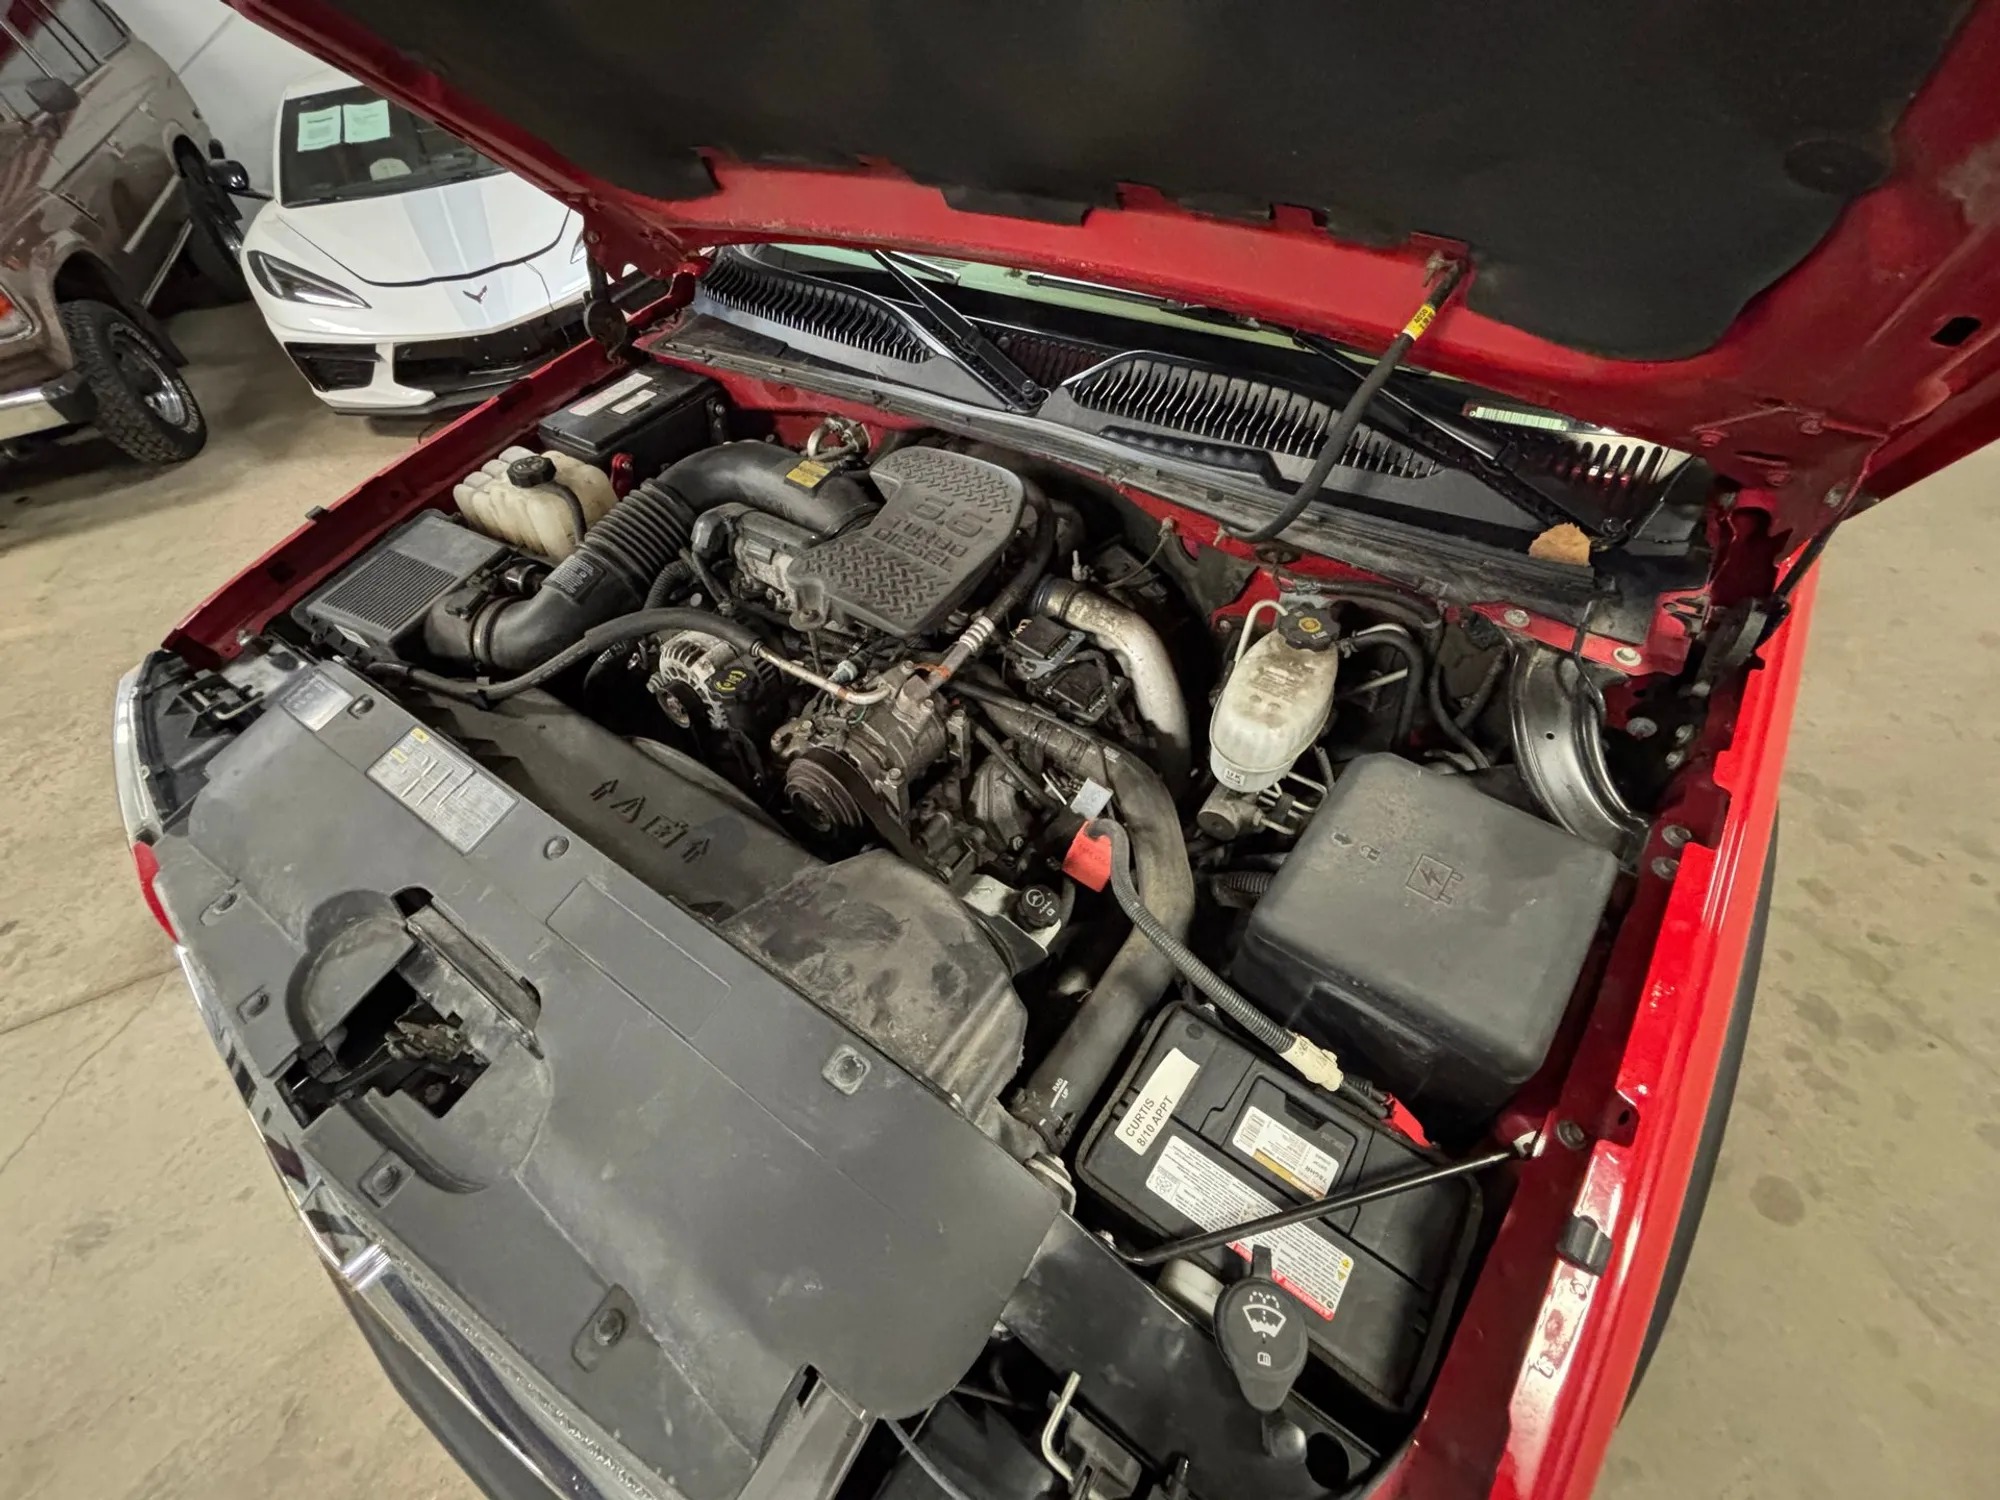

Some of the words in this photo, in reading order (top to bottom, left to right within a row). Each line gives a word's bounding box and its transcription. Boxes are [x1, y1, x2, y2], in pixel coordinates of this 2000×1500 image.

[872, 528, 953, 573] DIESEL
[892, 517, 969, 557] TURBO
[1125, 1098, 1155, 1137] CURTIS
[1136, 1124, 1156, 1147] 8/10
[1151, 1095, 1174, 1127] APPT
